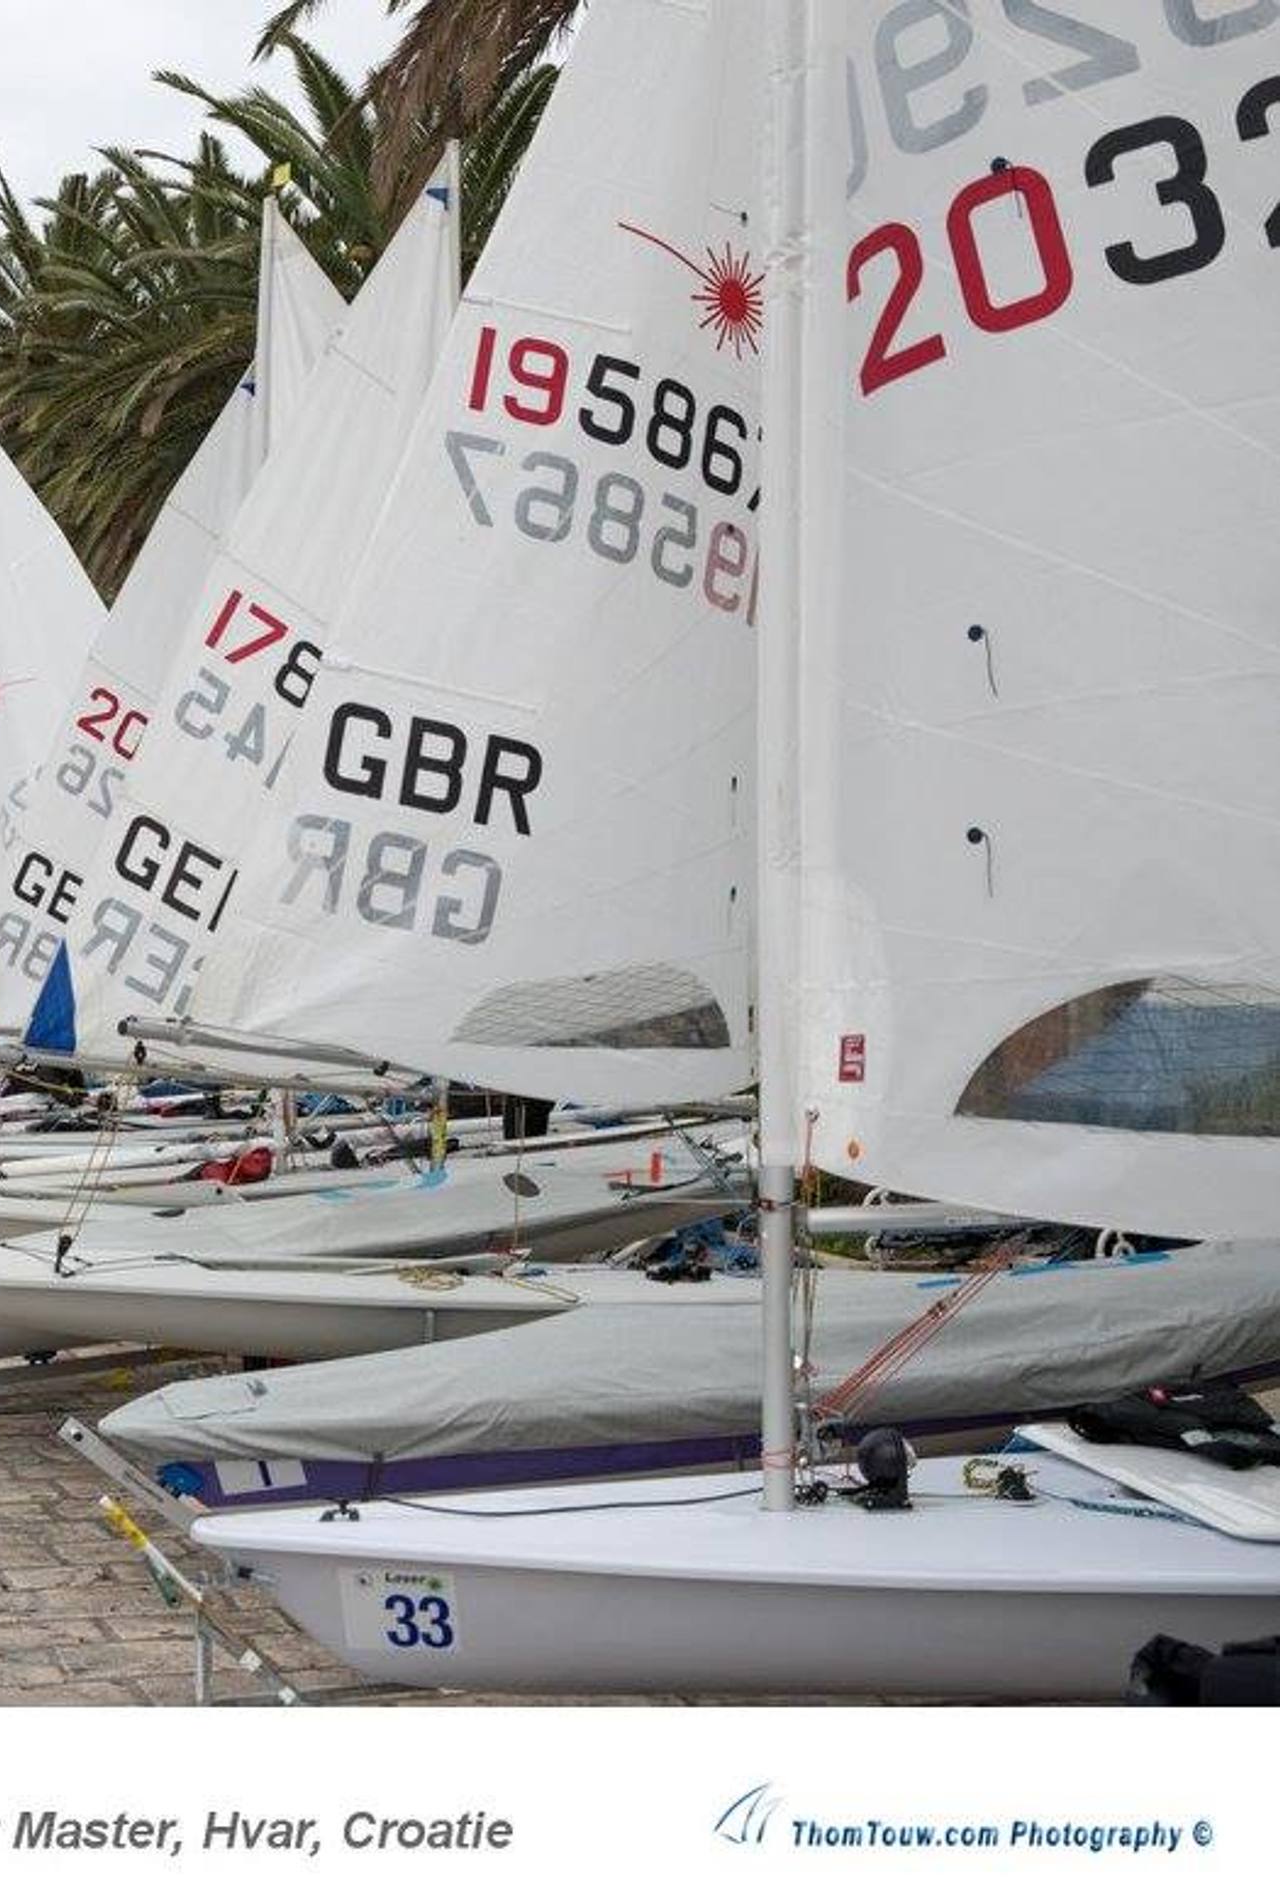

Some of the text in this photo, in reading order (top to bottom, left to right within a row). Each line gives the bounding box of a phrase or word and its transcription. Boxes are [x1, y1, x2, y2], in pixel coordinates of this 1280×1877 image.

[468, 327, 761, 511] 19586
[323, 702, 543, 836] GBR
[384, 1594, 454, 1648] 33
